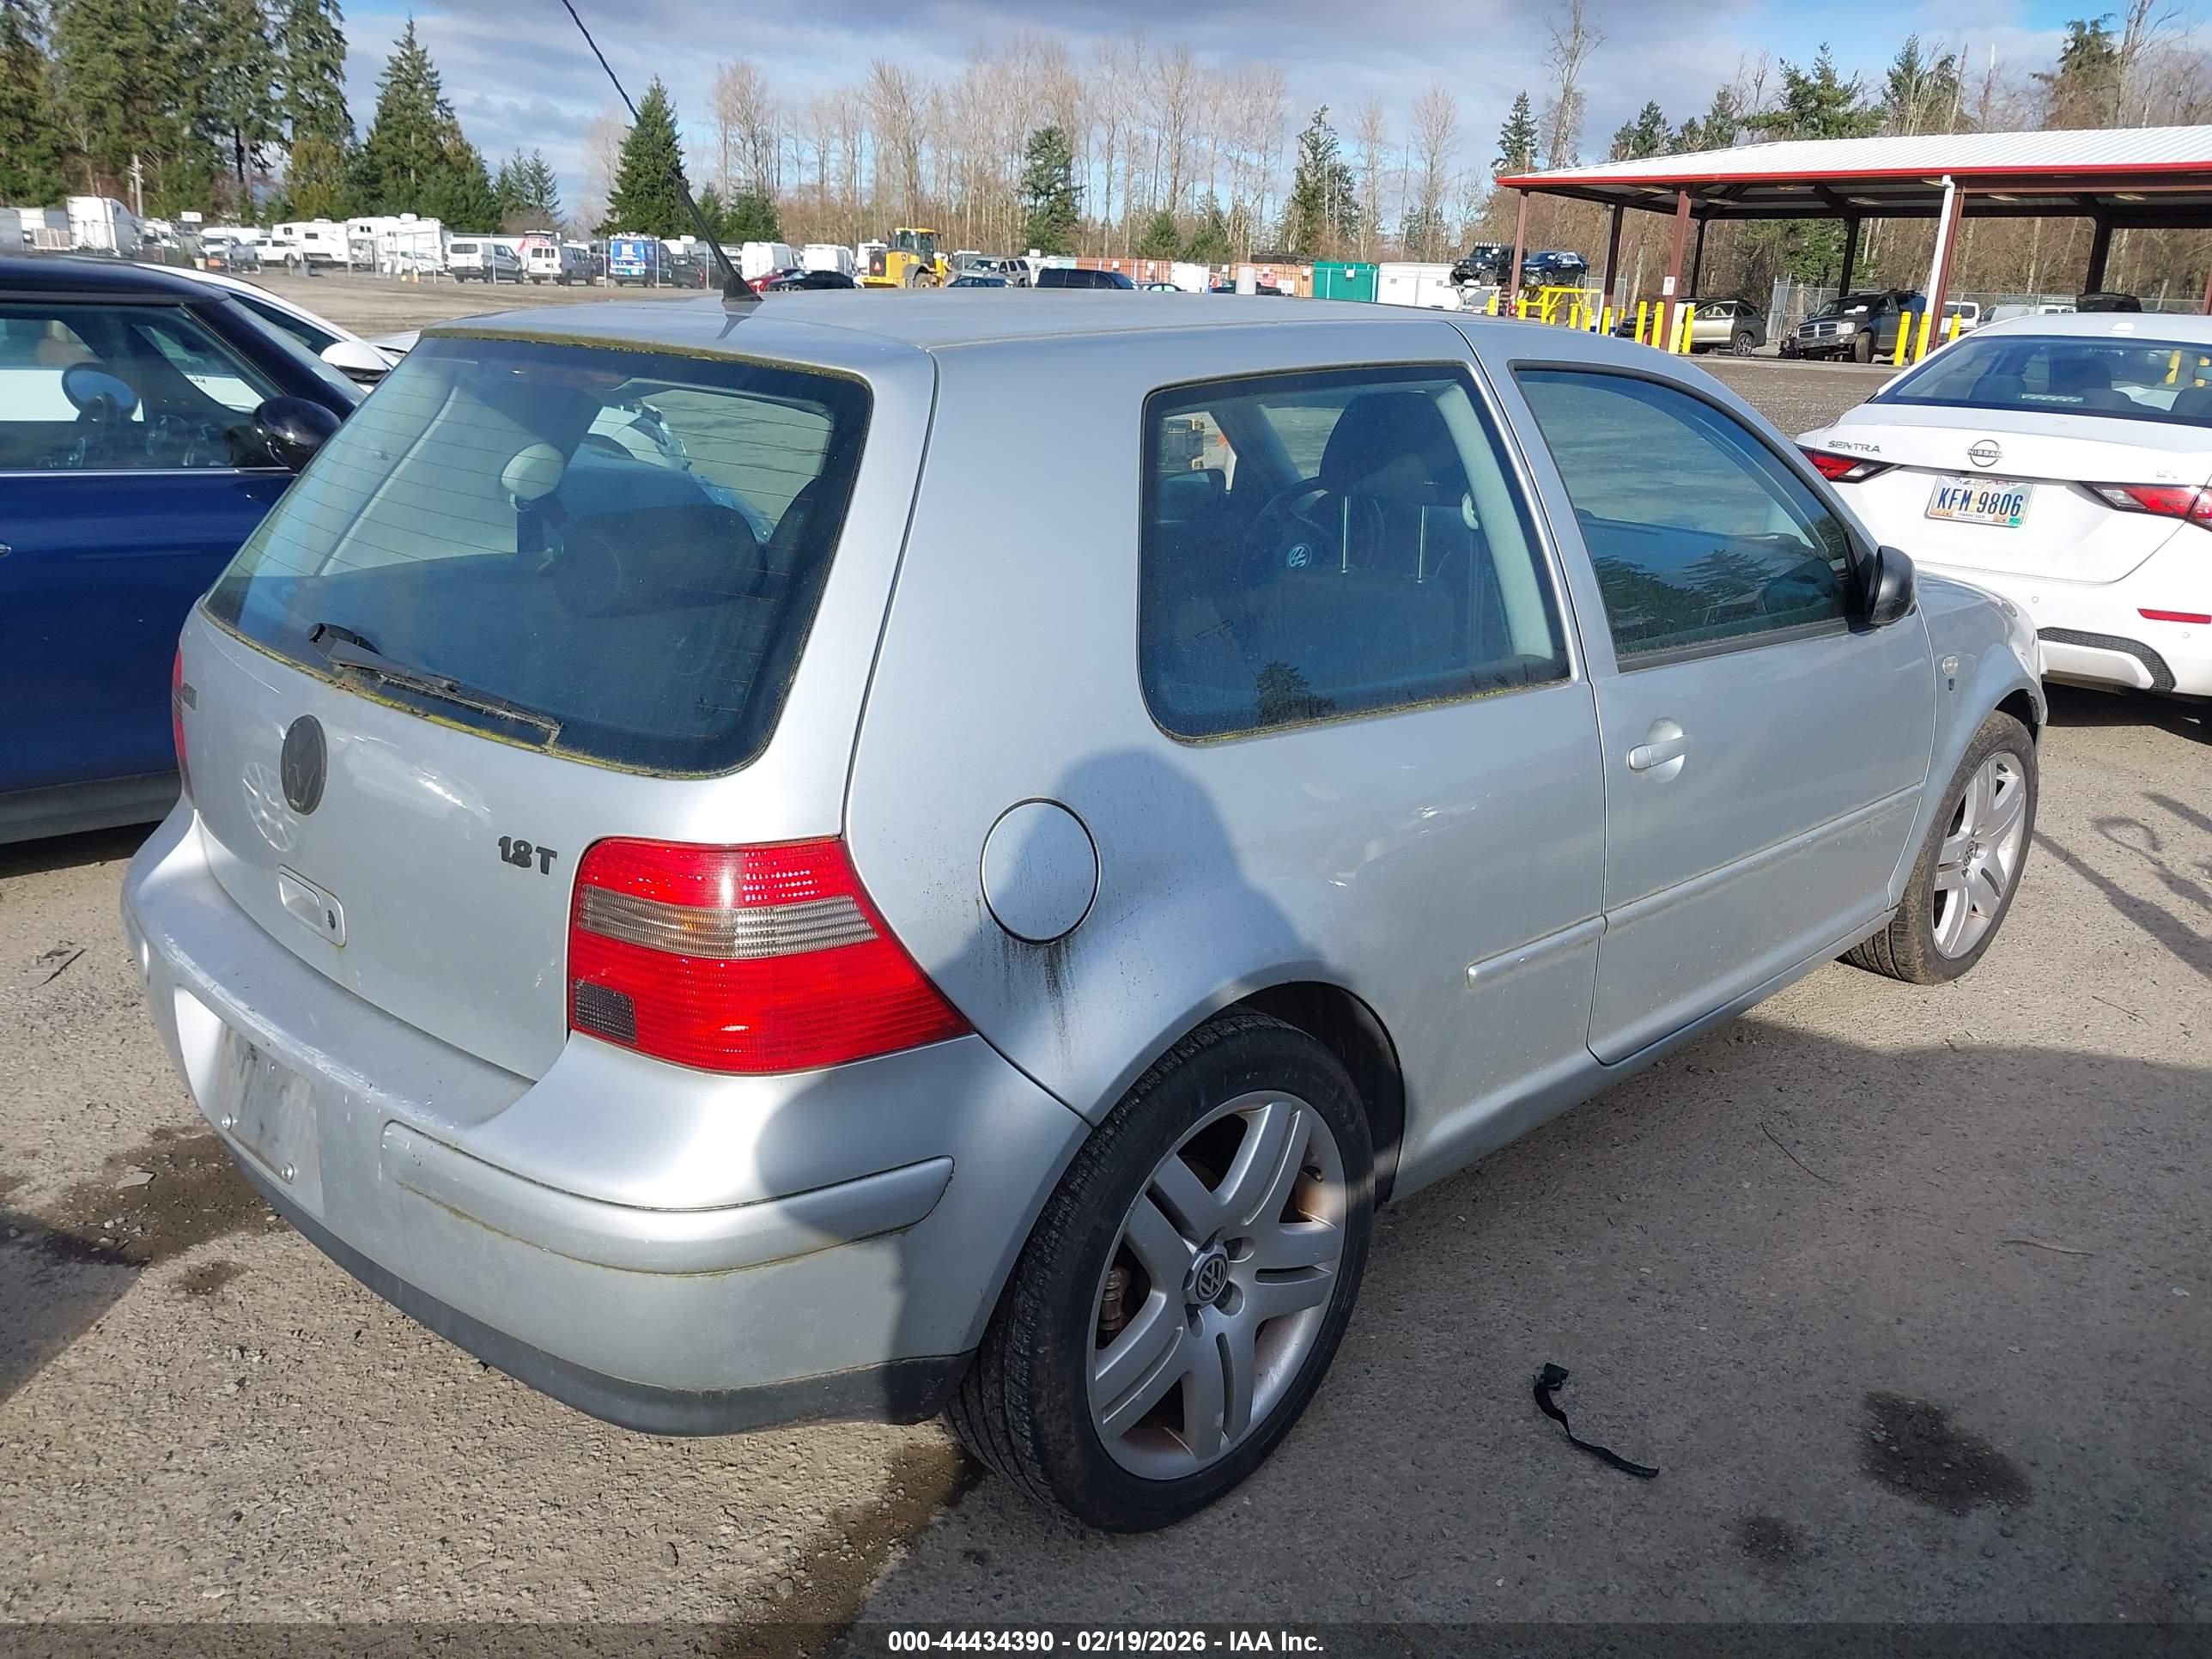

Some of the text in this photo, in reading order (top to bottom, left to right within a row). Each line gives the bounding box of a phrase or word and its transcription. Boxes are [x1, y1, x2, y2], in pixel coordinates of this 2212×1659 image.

[1827, 440, 1881, 453] SENTRA
[1967, 449, 2002, 458] NISSAN
[1937, 487, 2024, 517] KFM 9806
